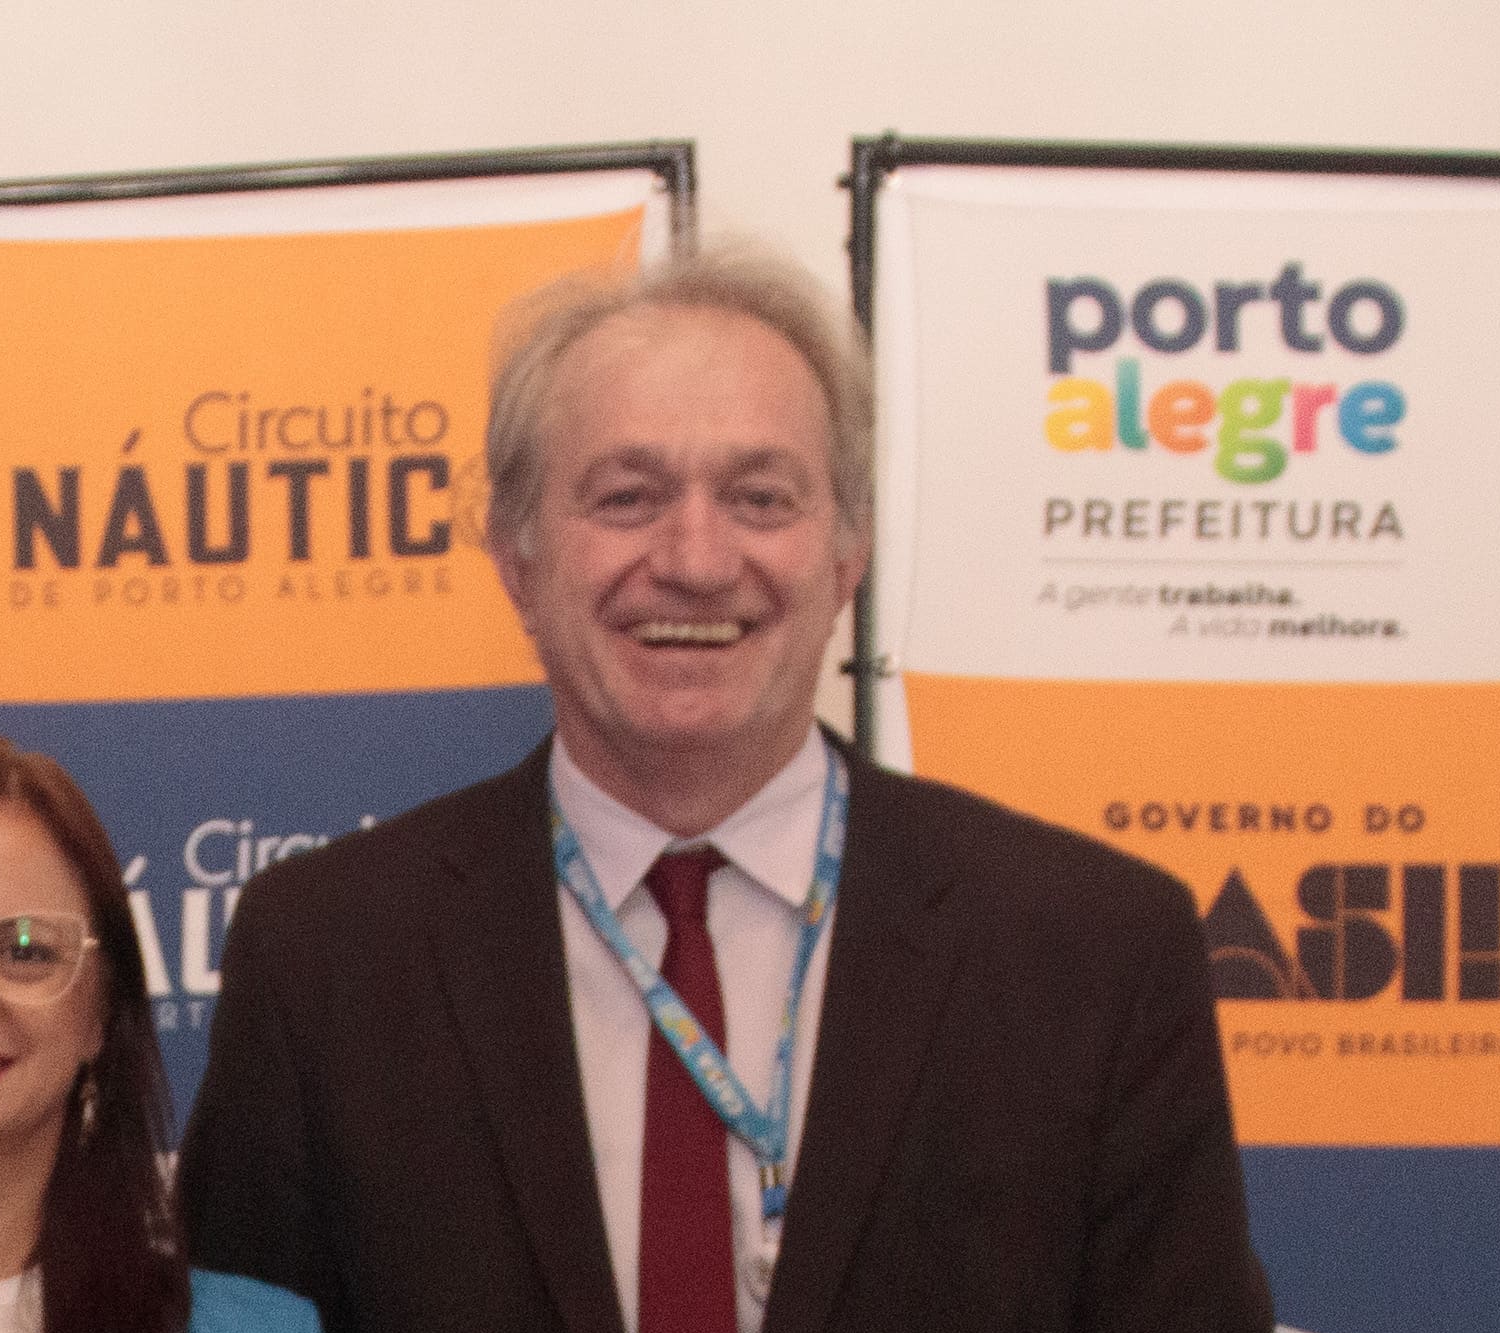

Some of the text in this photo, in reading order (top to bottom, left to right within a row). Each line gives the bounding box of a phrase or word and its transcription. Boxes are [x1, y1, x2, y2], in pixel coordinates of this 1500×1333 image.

[1044, 260, 1407, 375] porto
[184, 388, 448, 452] Circuito
[1044, 356, 1407, 484] alegre
[1044, 500, 1404, 540] PREFEITURA
[10, 569, 452, 608] DE PORTO ALEGRE
[1104, 802, 1427, 833] GOVERNO DO
[1232, 1031, 1323, 1056] POVO
